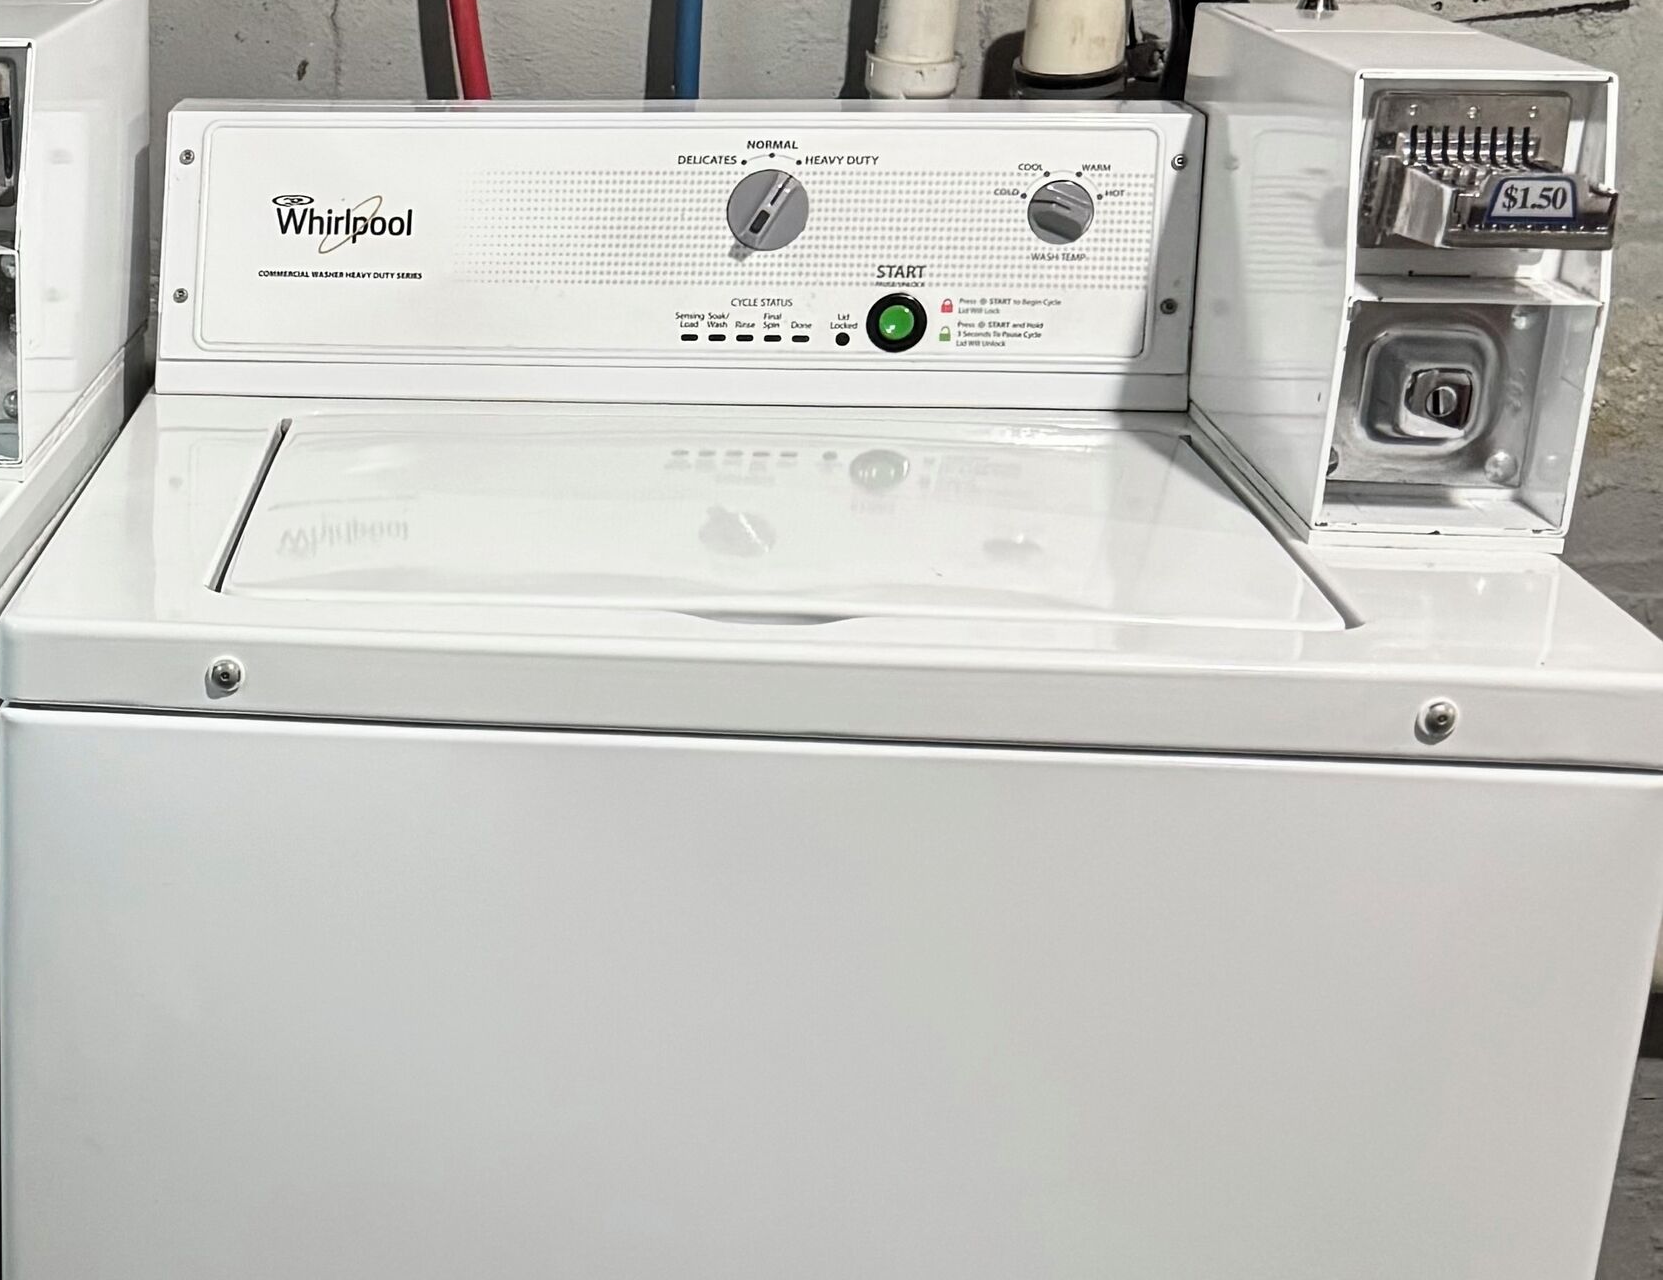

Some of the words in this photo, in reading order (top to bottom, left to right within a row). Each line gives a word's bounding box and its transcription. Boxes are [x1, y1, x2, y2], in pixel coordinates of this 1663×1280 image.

[746, 140, 799, 150] NORMAL
[677, 155, 738, 165] DELICATES
[805, 156, 844, 165] HEAVY
[846, 156, 879, 165] DUTY
[1017, 163, 1044, 171] COOL
[1081, 163, 1111, 172] WARM
[993, 188, 1020, 196] COLD
[1104, 189, 1126, 197] HOT
[1501, 183, 1567, 211] $1.50
[275, 207, 414, 245] Whirlpool
[1030, 252, 1060, 261] WASH
[1061, 253, 1086, 262] TEMP
[258, 270, 310, 278] COMMERCIAL
[311, 270, 344, 278] WASHER
[345, 271, 372, 279] HEAVY
[396, 272, 423, 280] SERIES
[876, 264, 927, 279] START
[730, 298, 759, 307] CYCLE
[760, 298, 793, 308] STATUS
[675, 311, 705, 320] Sensing
[708, 312, 730, 320] Soak/
[763, 312, 782, 320] Final
[707, 321, 728, 329] Wash
[735, 321, 755, 329] Rinse
[763, 321, 780, 330] Spin
[830, 322, 858, 330] Locked
